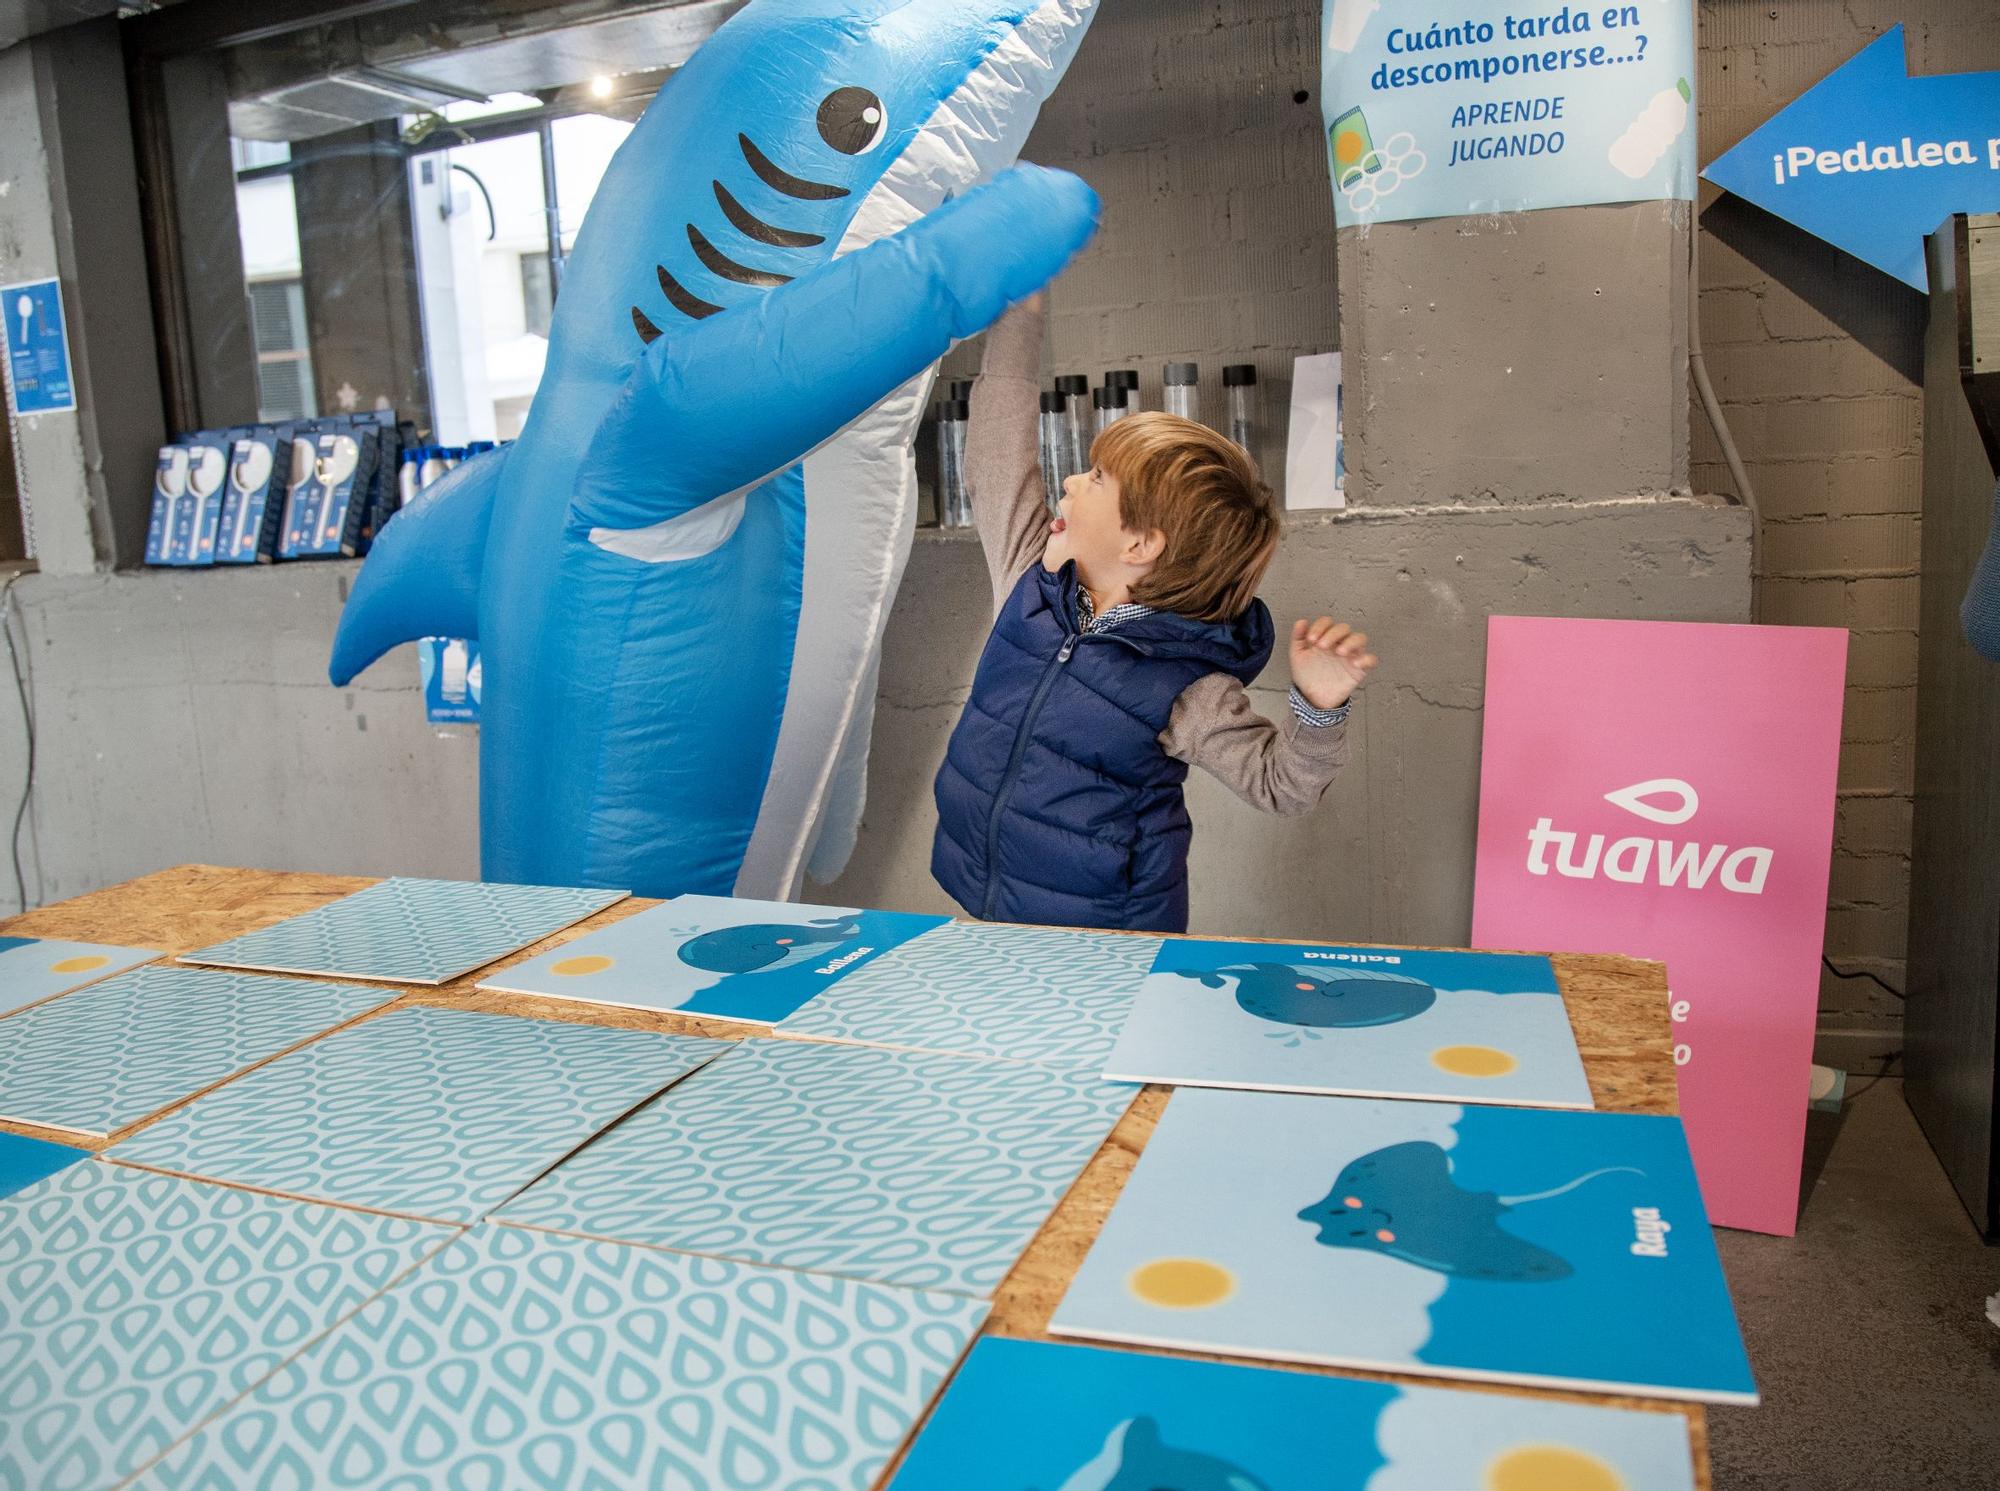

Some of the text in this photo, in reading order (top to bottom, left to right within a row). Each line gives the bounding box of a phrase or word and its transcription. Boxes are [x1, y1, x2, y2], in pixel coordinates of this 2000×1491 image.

[1386, 5, 1640, 55] Cuánto tarda en
[1371, 35, 1649, 91] descomponerse...?
[1451, 96, 1565, 129] APRENDE
[1447, 131, 1565, 167] JUGANDO
[1773, 137, 1978, 186] ¡Pedalea
[1526, 817, 1774, 895] tuawa
[815, 946, 874, 975] Ballena
[1303, 951, 1401, 964] Ballena
[1630, 1206, 1672, 1257] Raya
